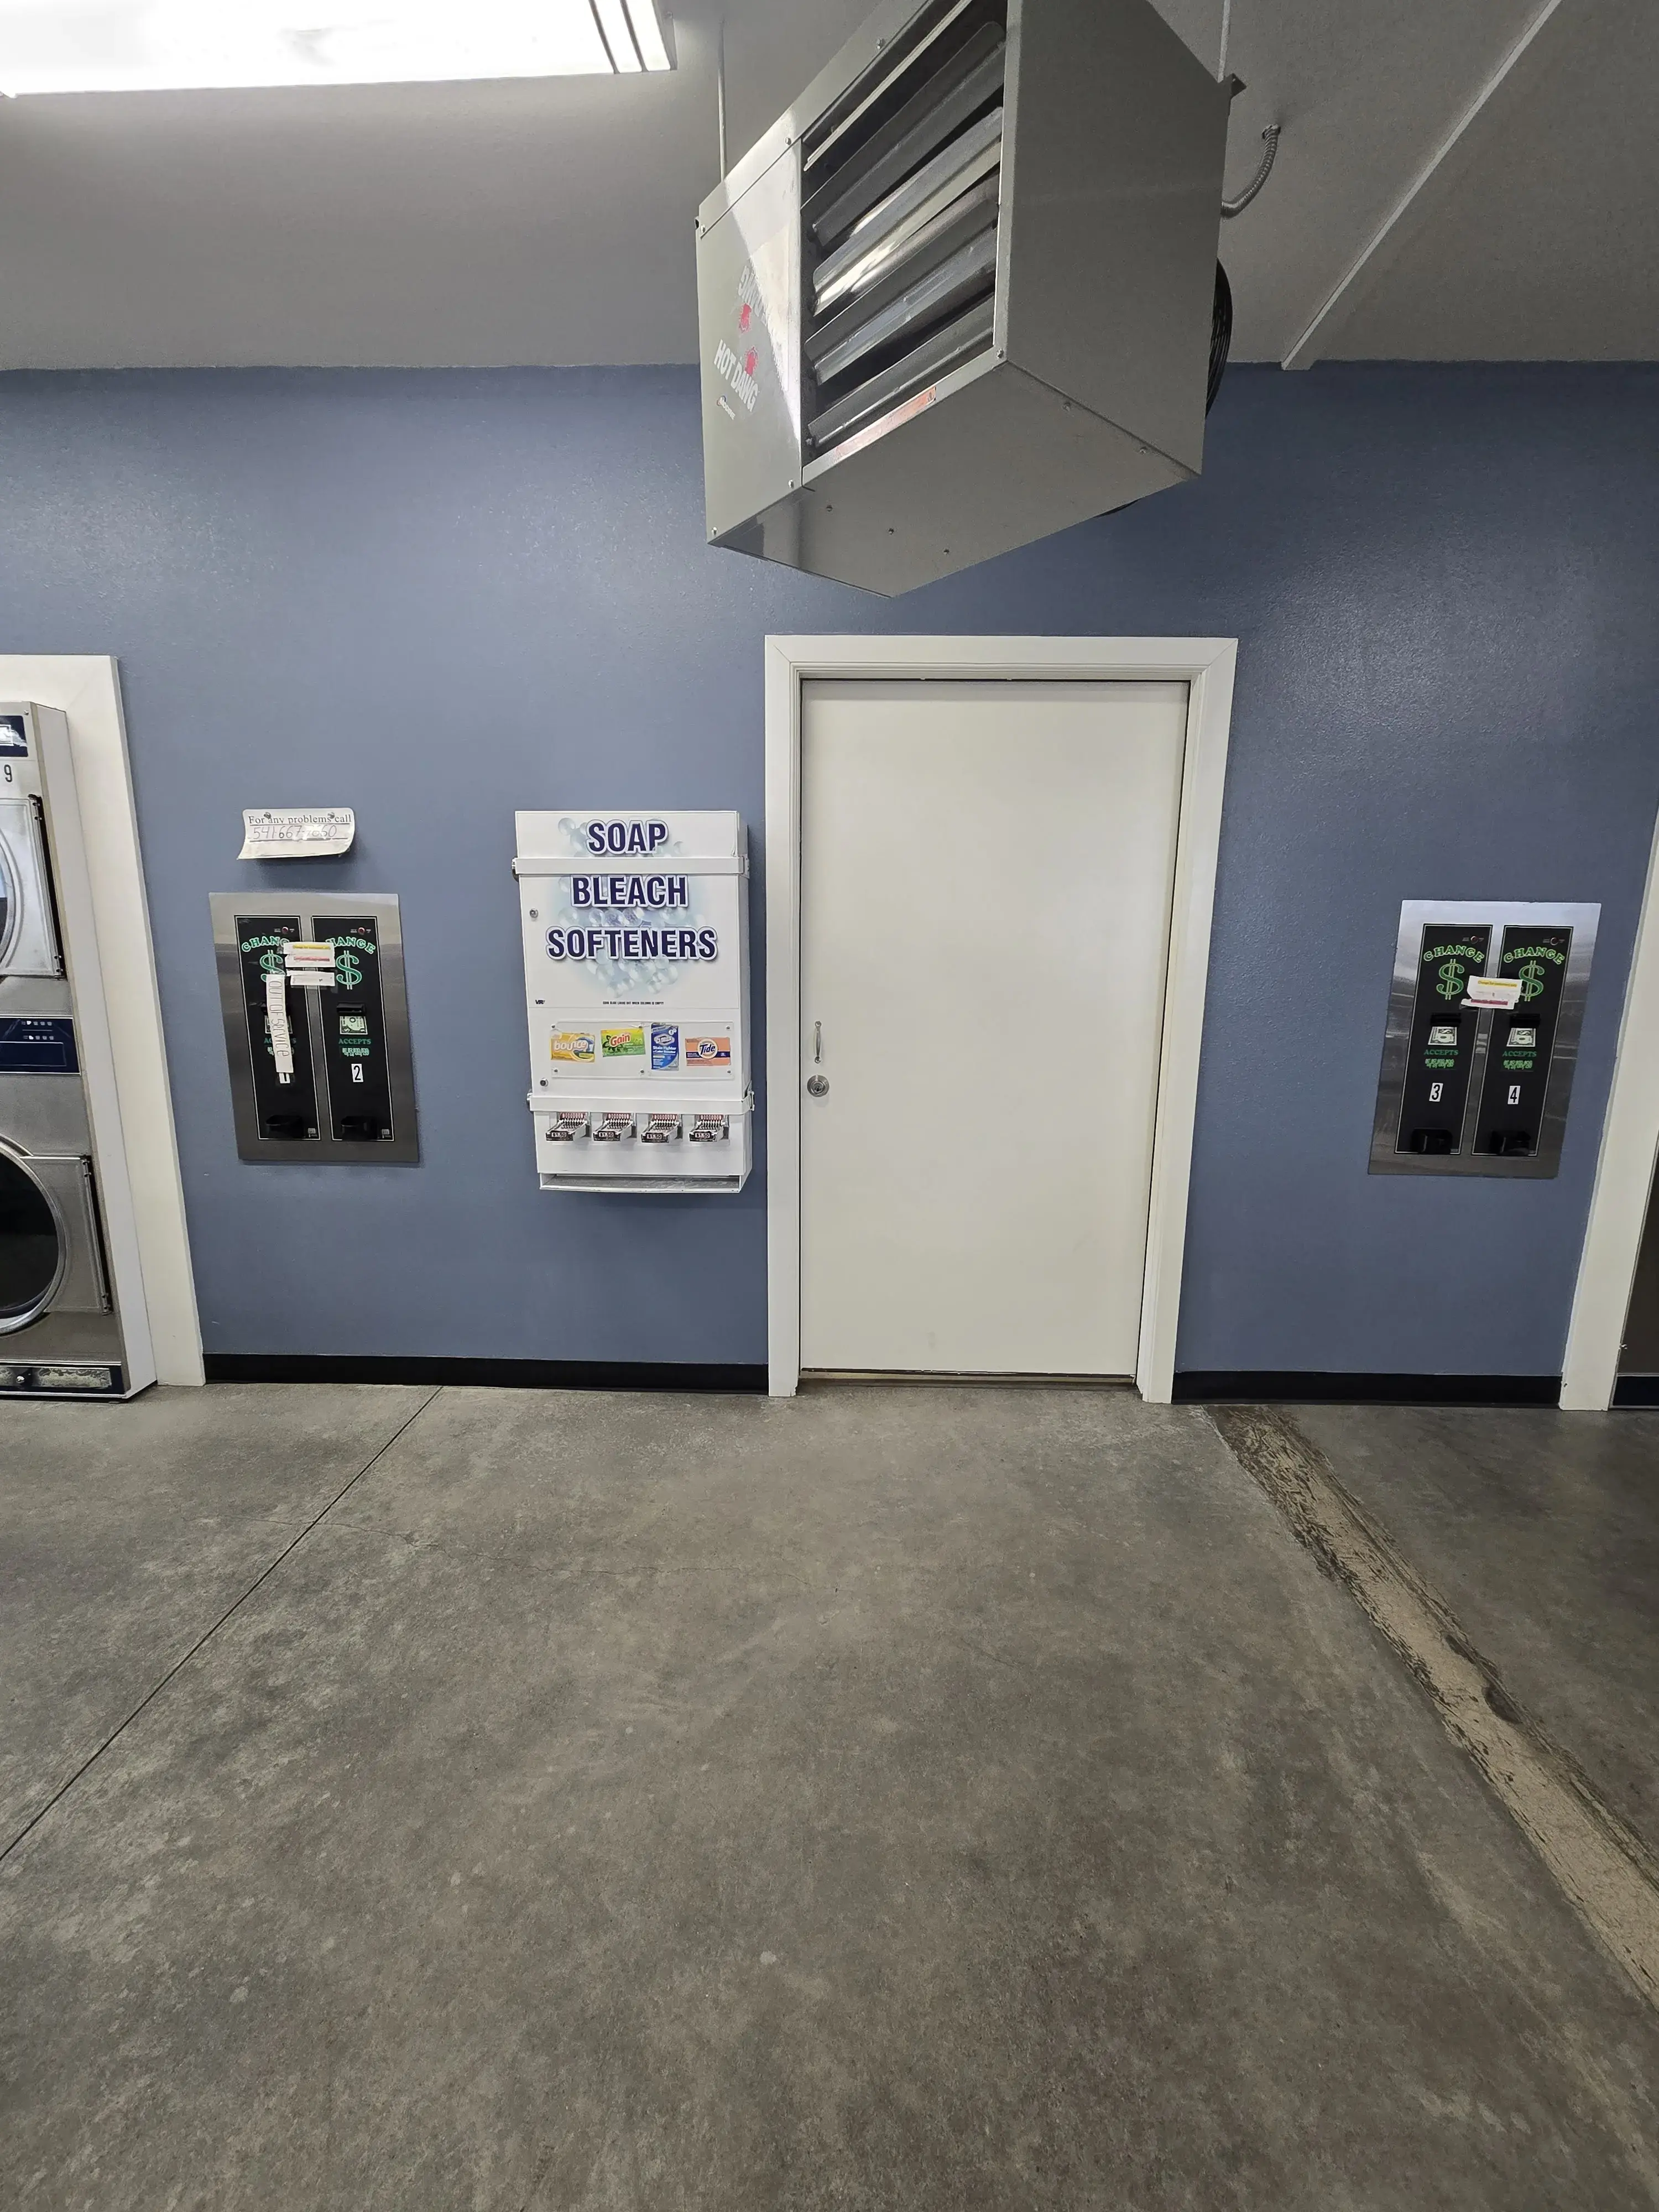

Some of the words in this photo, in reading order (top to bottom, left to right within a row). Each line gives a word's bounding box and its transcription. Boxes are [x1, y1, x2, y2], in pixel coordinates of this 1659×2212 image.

[713, 338, 737, 380] HOT
[730, 361, 758, 413] DAWG
[4, 764, 13, 782] 9
[288, 815, 331, 825] problems
[335, 815, 352, 823] call
[587, 822, 667, 853] SOAP
[572, 875, 687, 906] BLEACH
[547, 928, 716, 958] SOFTENERS
[1423, 945, 1485, 963] CHANGE
[1504, 947, 1565, 965] CHANGE
[269, 980, 283, 999] OUT
[269, 1004, 285, 1015] OF
[554, 1040, 588, 1051] bounce
[610, 1033, 631, 1047] Gain
[700, 1044, 716, 1055] Tide
[353, 1065, 361, 1081] 2
[1431, 1084, 1441, 1100] 3
[1510, 1087, 1517, 1103] 4
